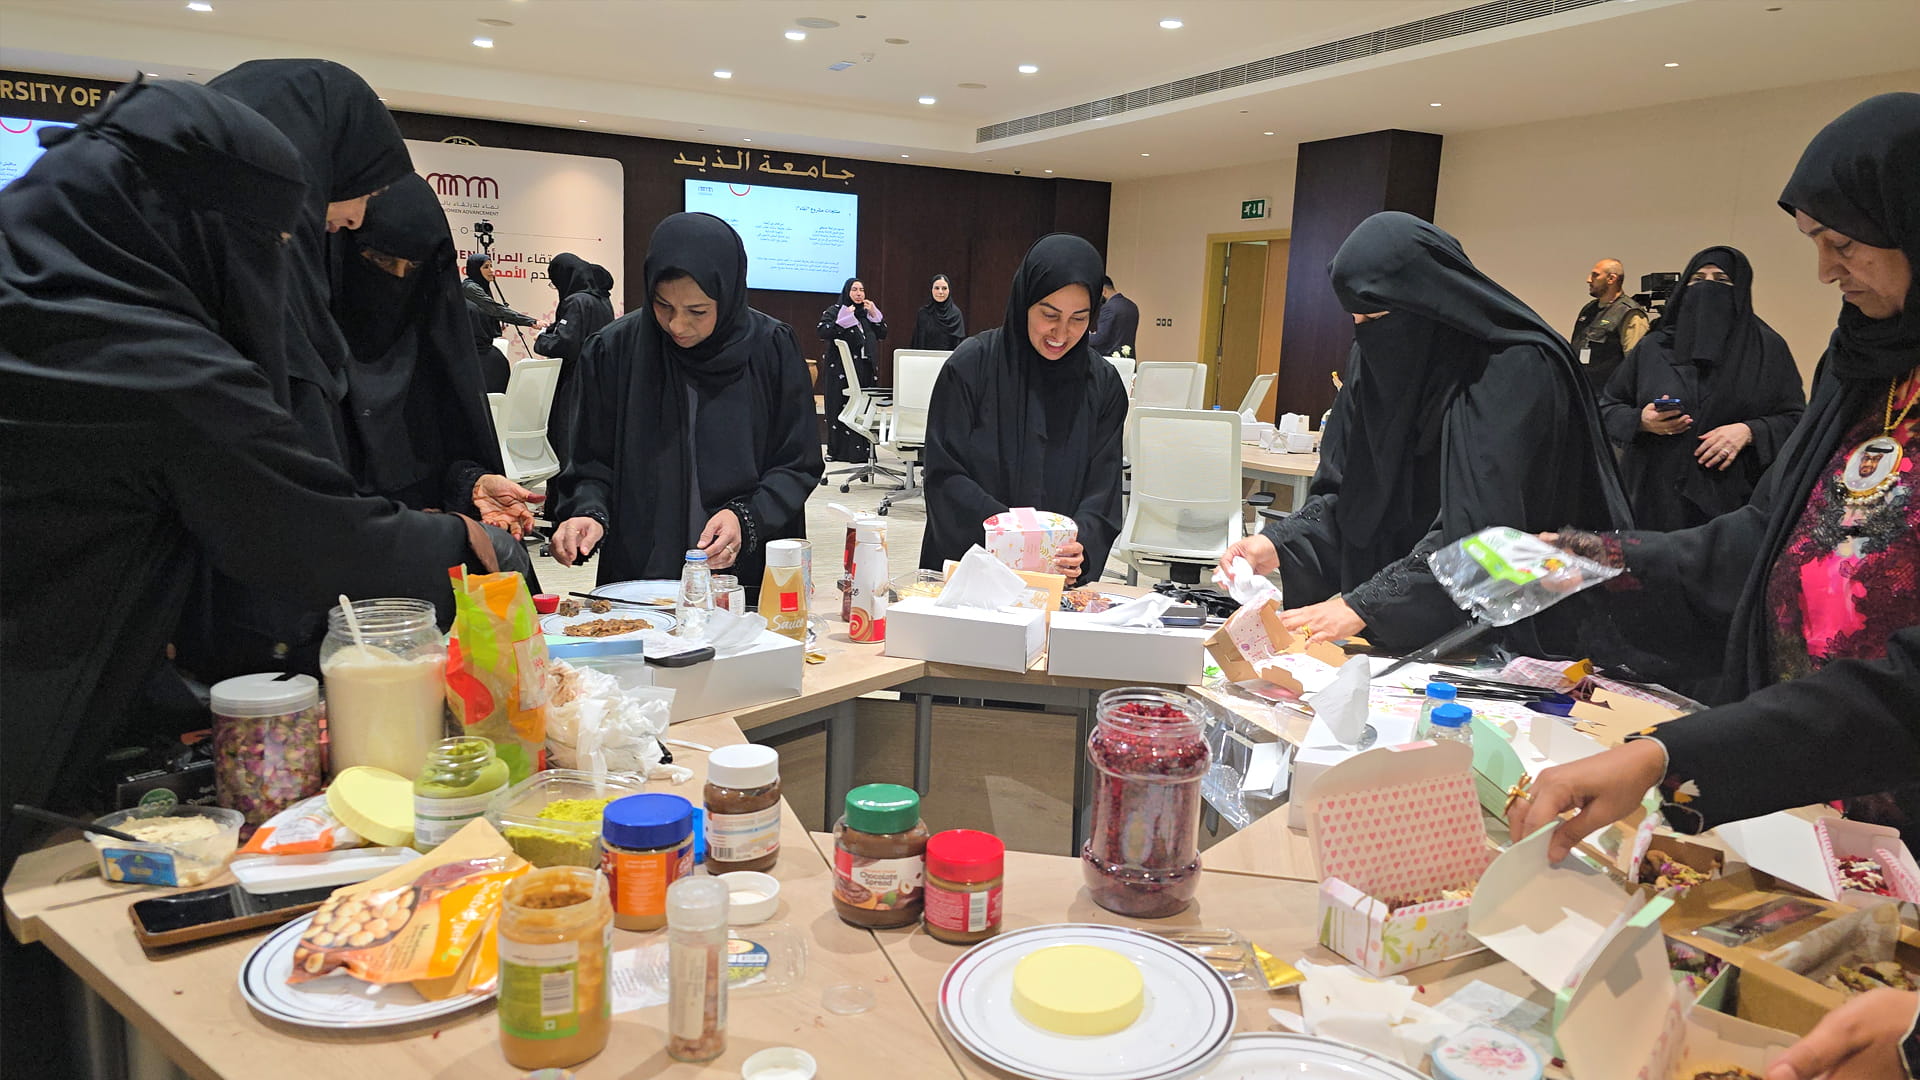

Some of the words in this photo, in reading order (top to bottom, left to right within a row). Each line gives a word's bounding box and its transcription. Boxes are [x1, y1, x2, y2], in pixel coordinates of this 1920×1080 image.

[70, 86, 101, 107] OF
[673, 149, 750, 172] الذيد
[758, 154, 855, 185] جامعة
[859, 871, 898, 880] Chocolate
[865, 878, 893, 887] Spread
